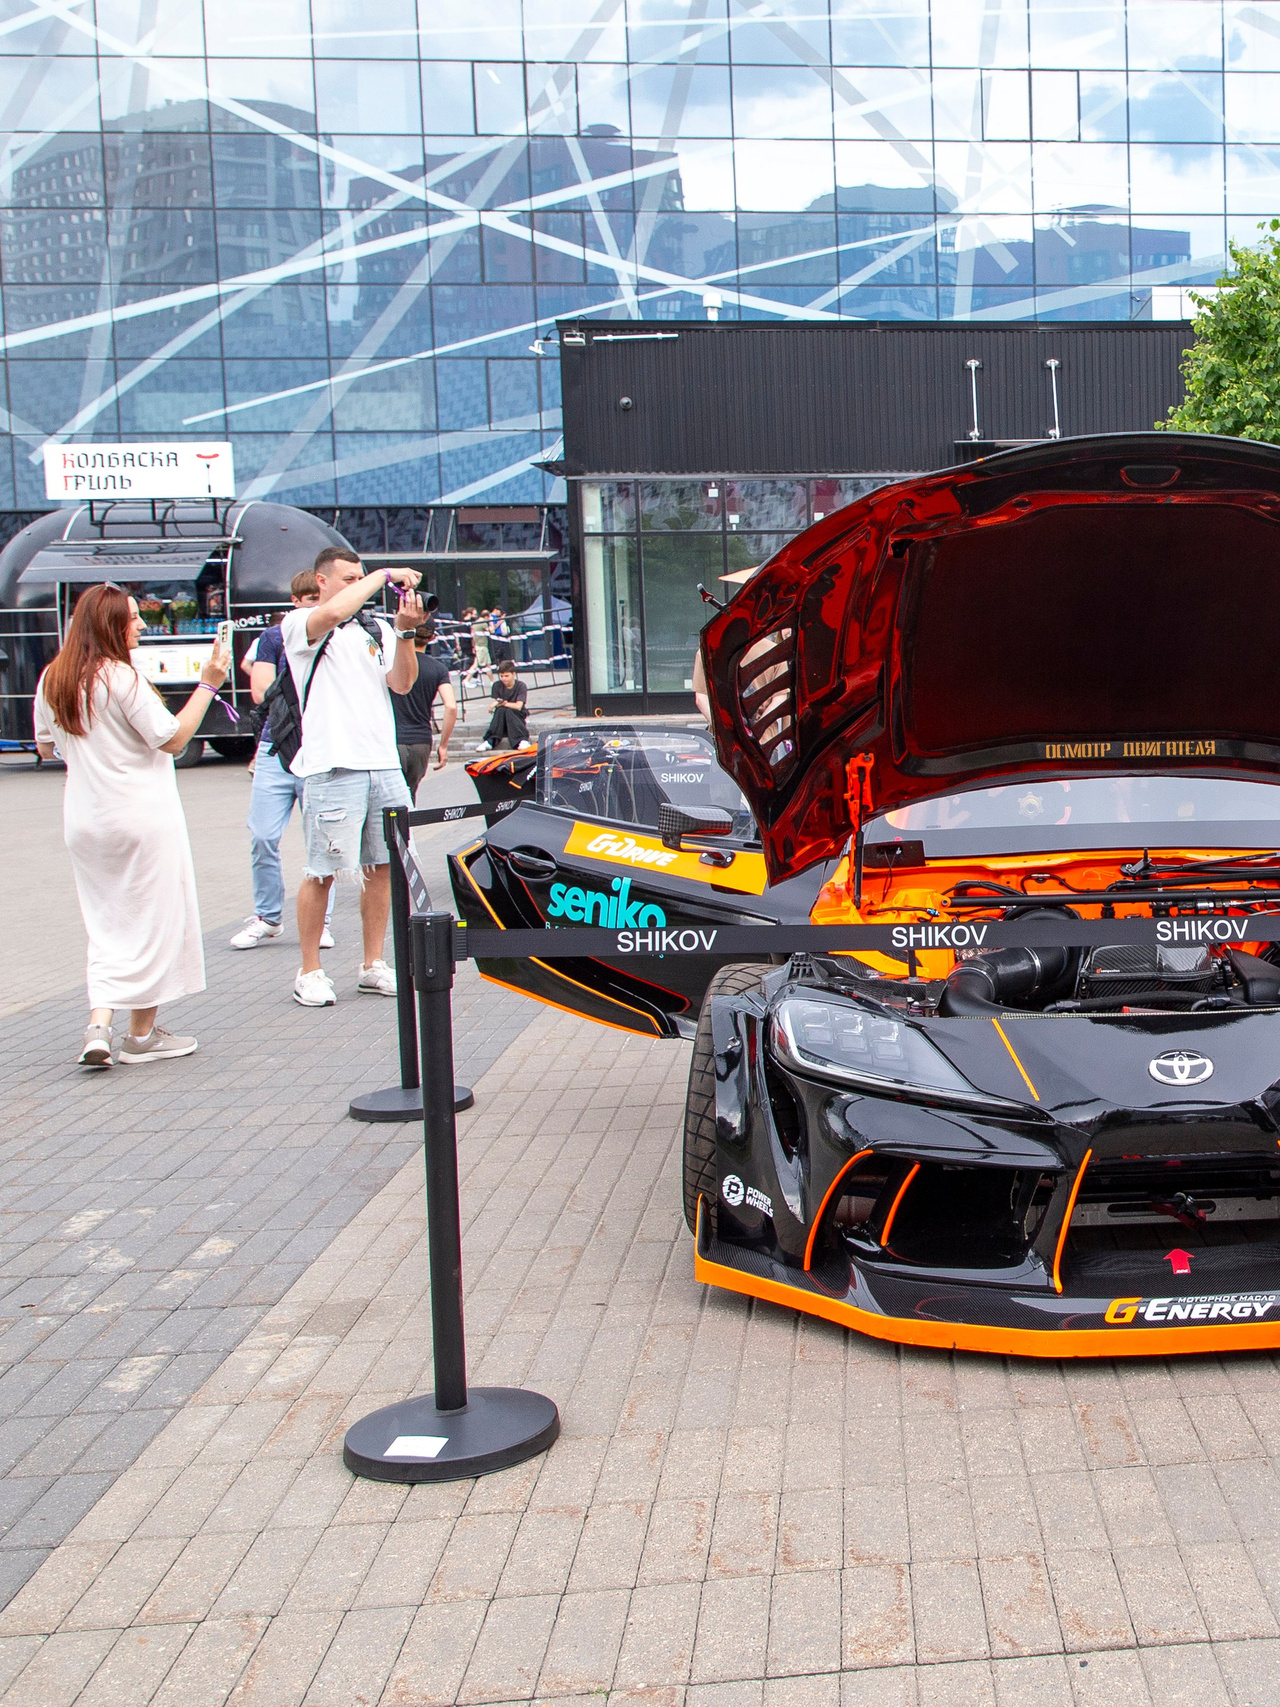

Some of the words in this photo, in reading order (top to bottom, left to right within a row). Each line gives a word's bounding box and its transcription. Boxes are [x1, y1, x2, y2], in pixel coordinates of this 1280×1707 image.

[62, 452, 179, 469] КОЛБАСКА
[63, 475, 132, 491] ГРИЛЬ
[1045, 742, 1111, 759] ОСМОТР
[1122, 740, 1216, 757] ДВИГАТЕЛЯ
[661, 773, 704, 783] SHIKOV
[547, 876, 667, 929] seniko
[616, 930, 718, 952] SHIKOV
[891, 925, 988, 948] SHIKOV
[1156, 920, 1249, 942] SHIKOV
[745, 1194, 774, 1217] WHEELS
[746, 1186, 772, 1207] POWER
